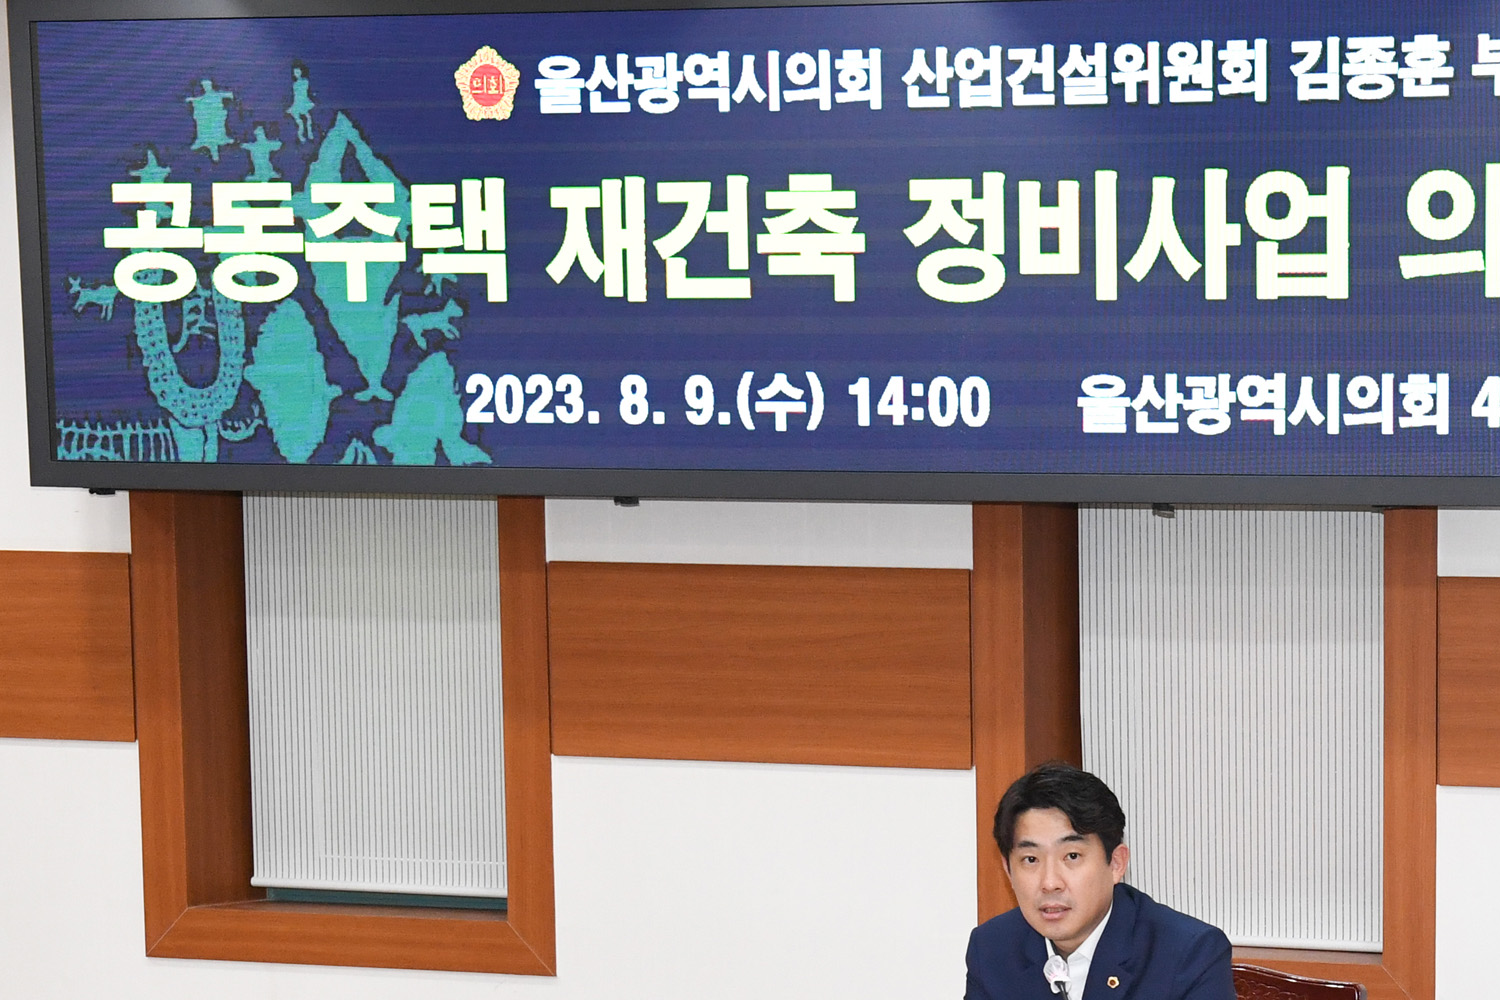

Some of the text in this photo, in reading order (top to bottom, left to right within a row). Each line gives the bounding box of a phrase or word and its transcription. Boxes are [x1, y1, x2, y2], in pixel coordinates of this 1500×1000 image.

[471, 74, 503, 95] 의회
[533, 48, 883, 115] 울산광역시의회
[900, 38, 1269, 110] 산업건설위원회
[1289, 34, 1455, 101] 김종훈
[103, 177, 508, 304] 공동주택
[545, 174, 866, 303] 재건축
[903, 166, 1351, 304] 정비사업
[465, 373, 601, 425] 2023.
[619, 374, 666, 425] 8.
[684, 371, 826, 432] 9.(수)
[848, 376, 991, 428] 14:00
[1077, 372, 1451, 437] 울산광역시의회
